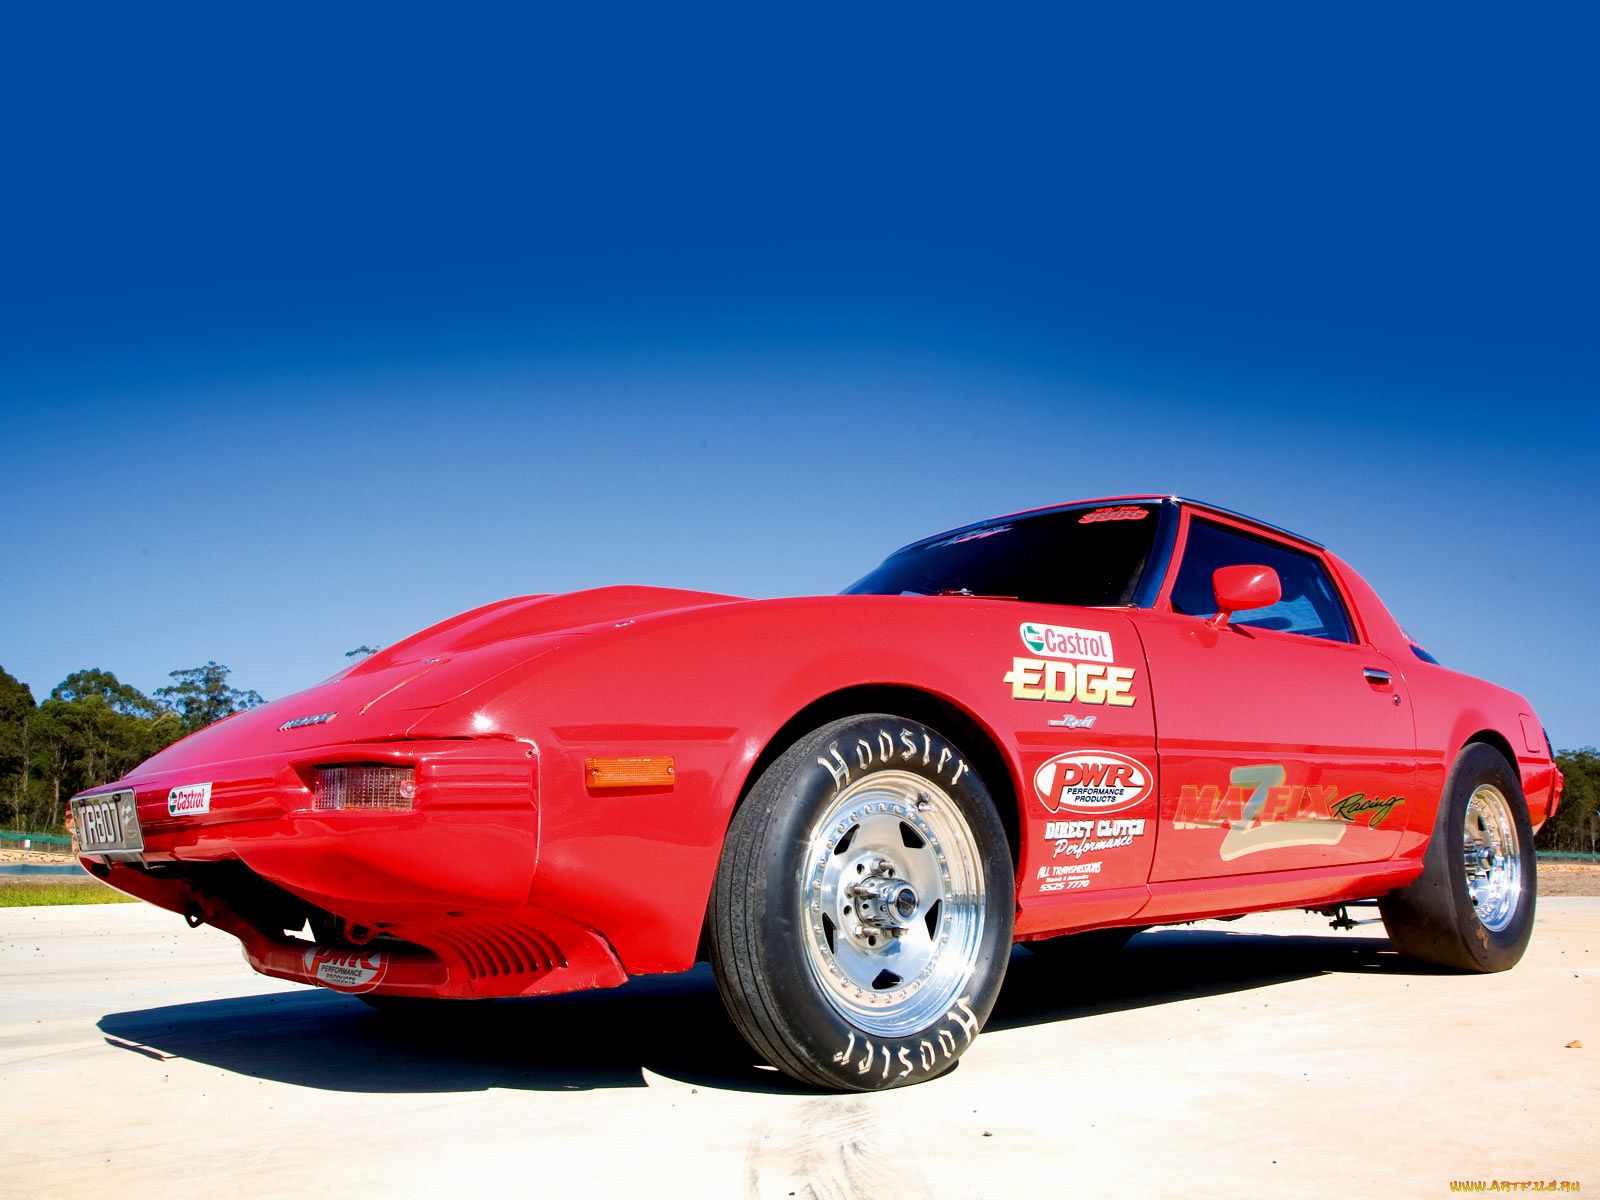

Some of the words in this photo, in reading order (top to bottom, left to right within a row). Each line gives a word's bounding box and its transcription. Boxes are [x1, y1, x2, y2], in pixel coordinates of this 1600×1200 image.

[1044, 628, 1108, 658] Castrol
[1003, 657, 1137, 707] EDGE
[1047, 762, 1145, 809] PWR
[1066, 787, 1125, 796] PERFORMANCE
[176, 788, 205, 811] Castrol
[1074, 795, 1117, 803] PRODUCTS
[1330, 793, 1406, 831] Racing
[1045, 820, 1095, 840] DIRECT
[1097, 818, 1146, 838] CLUTCH
[1052, 835, 1133, 859] Performance
[1037, 866, 1050, 880] ALL
[320, 964, 363, 978] PERFORMANCE
